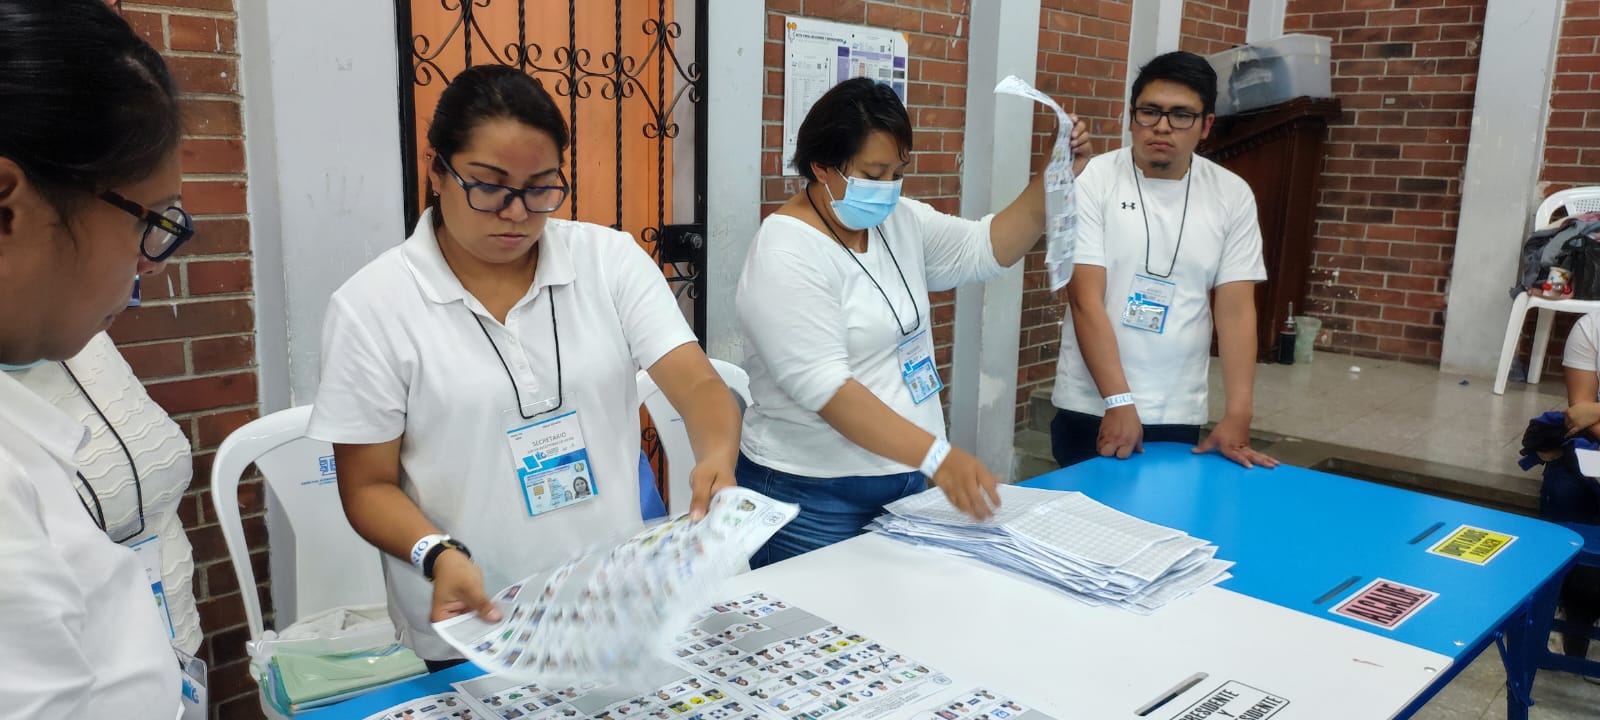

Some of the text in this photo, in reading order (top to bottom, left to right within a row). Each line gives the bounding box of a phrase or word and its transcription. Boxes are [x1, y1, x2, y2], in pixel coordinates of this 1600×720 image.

[1344, 582, 1428, 625] ALCALDE
[1178, 688, 1241, 720] RESIDENTE
[1216, 708, 1236, 718] Y
